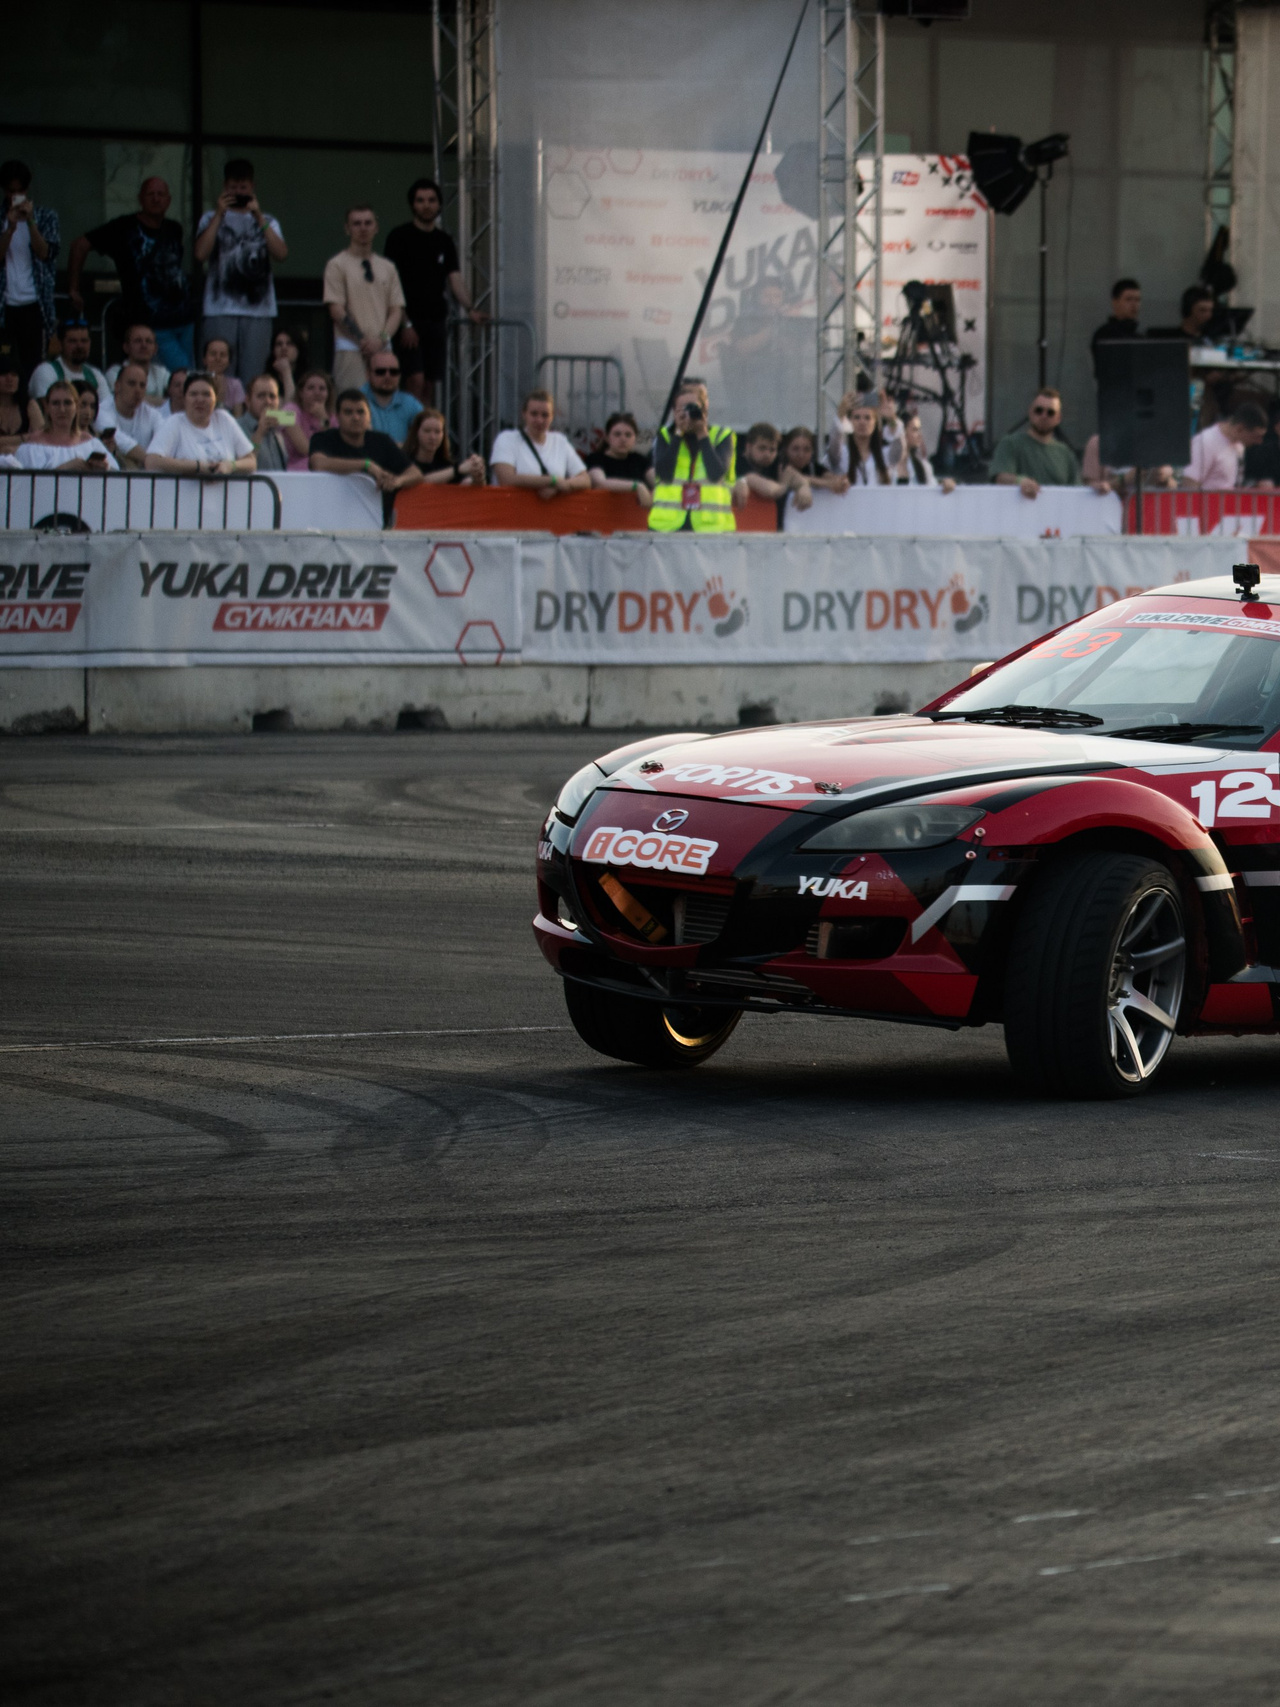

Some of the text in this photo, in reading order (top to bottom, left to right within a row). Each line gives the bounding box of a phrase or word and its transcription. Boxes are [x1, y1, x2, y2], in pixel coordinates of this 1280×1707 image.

[0, 563, 92, 599] RIVE
[139, 562, 398, 598] YUKA DRIVE
[223, 604, 376, 629] GYMKHANA
[534, 590, 699, 634] DRYDRY
[782, 589, 944, 632] DRYDRY
[1173, 614, 1230, 625] DRIVE
[645, 763, 813, 795] FORTIS
[797, 875, 869, 901] YUKA
